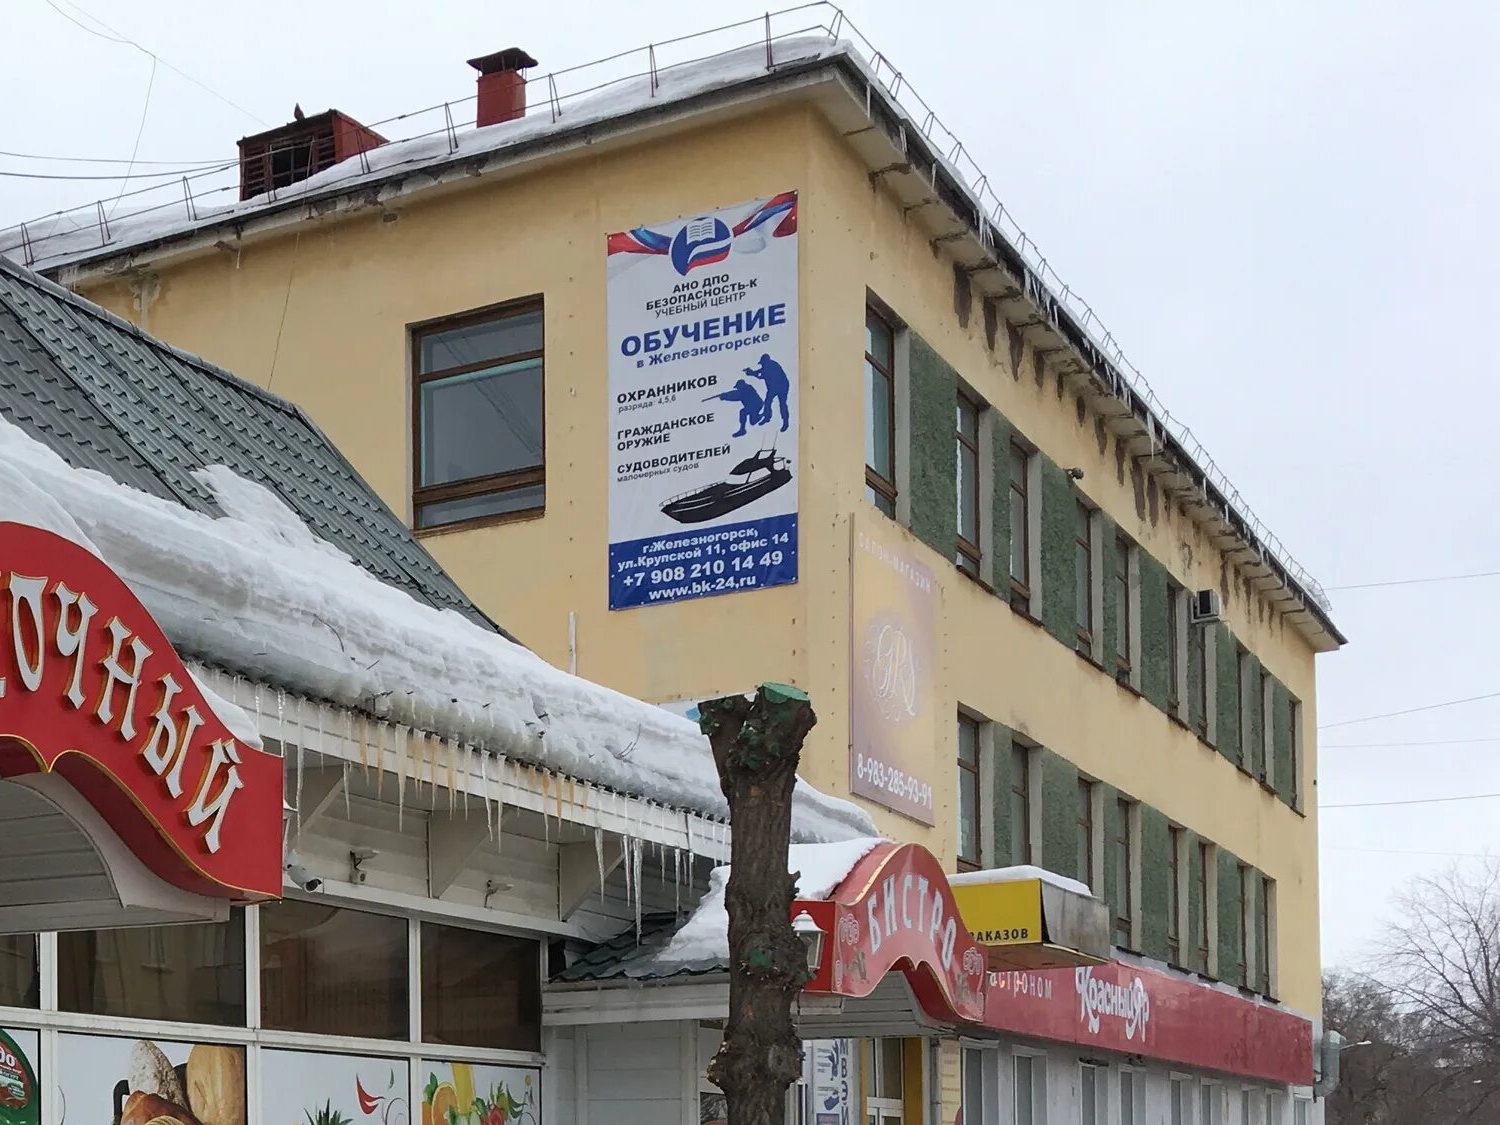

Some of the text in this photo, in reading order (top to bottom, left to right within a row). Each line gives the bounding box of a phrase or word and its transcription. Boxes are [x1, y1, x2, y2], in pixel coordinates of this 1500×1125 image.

[646, 278, 758, 311] БЕЗОПАСНОСТЬ-К
[673, 274, 729, 294] АНО ДПО
[655, 291, 746, 319] УЧЕБНЫЙ ЦЕНТР
[621, 303, 786, 357] ОБУЧЕНИЕ
[636, 332, 770, 369] в Железногорске
[617, 375, 718, 404] ОХРАННИКОВ
[657, 395, 677, 406] 4,5,6
[617, 413, 715, 440] ГРАЖДАНСКОЕ
[617, 433, 671, 451] ОРУЖИЕ
[617, 443, 731, 474] СУДОВОДИТЕЛЕЙ
[617, 462, 699, 483] маломерных судов
[617, 533, 790, 573] ул.Крупской 11, офис 14
[623, 550, 783, 587] +7 908 210 14 49
[867, 873, 957, 972] БИСТРО
[989, 972, 1052, 1000] астроном
